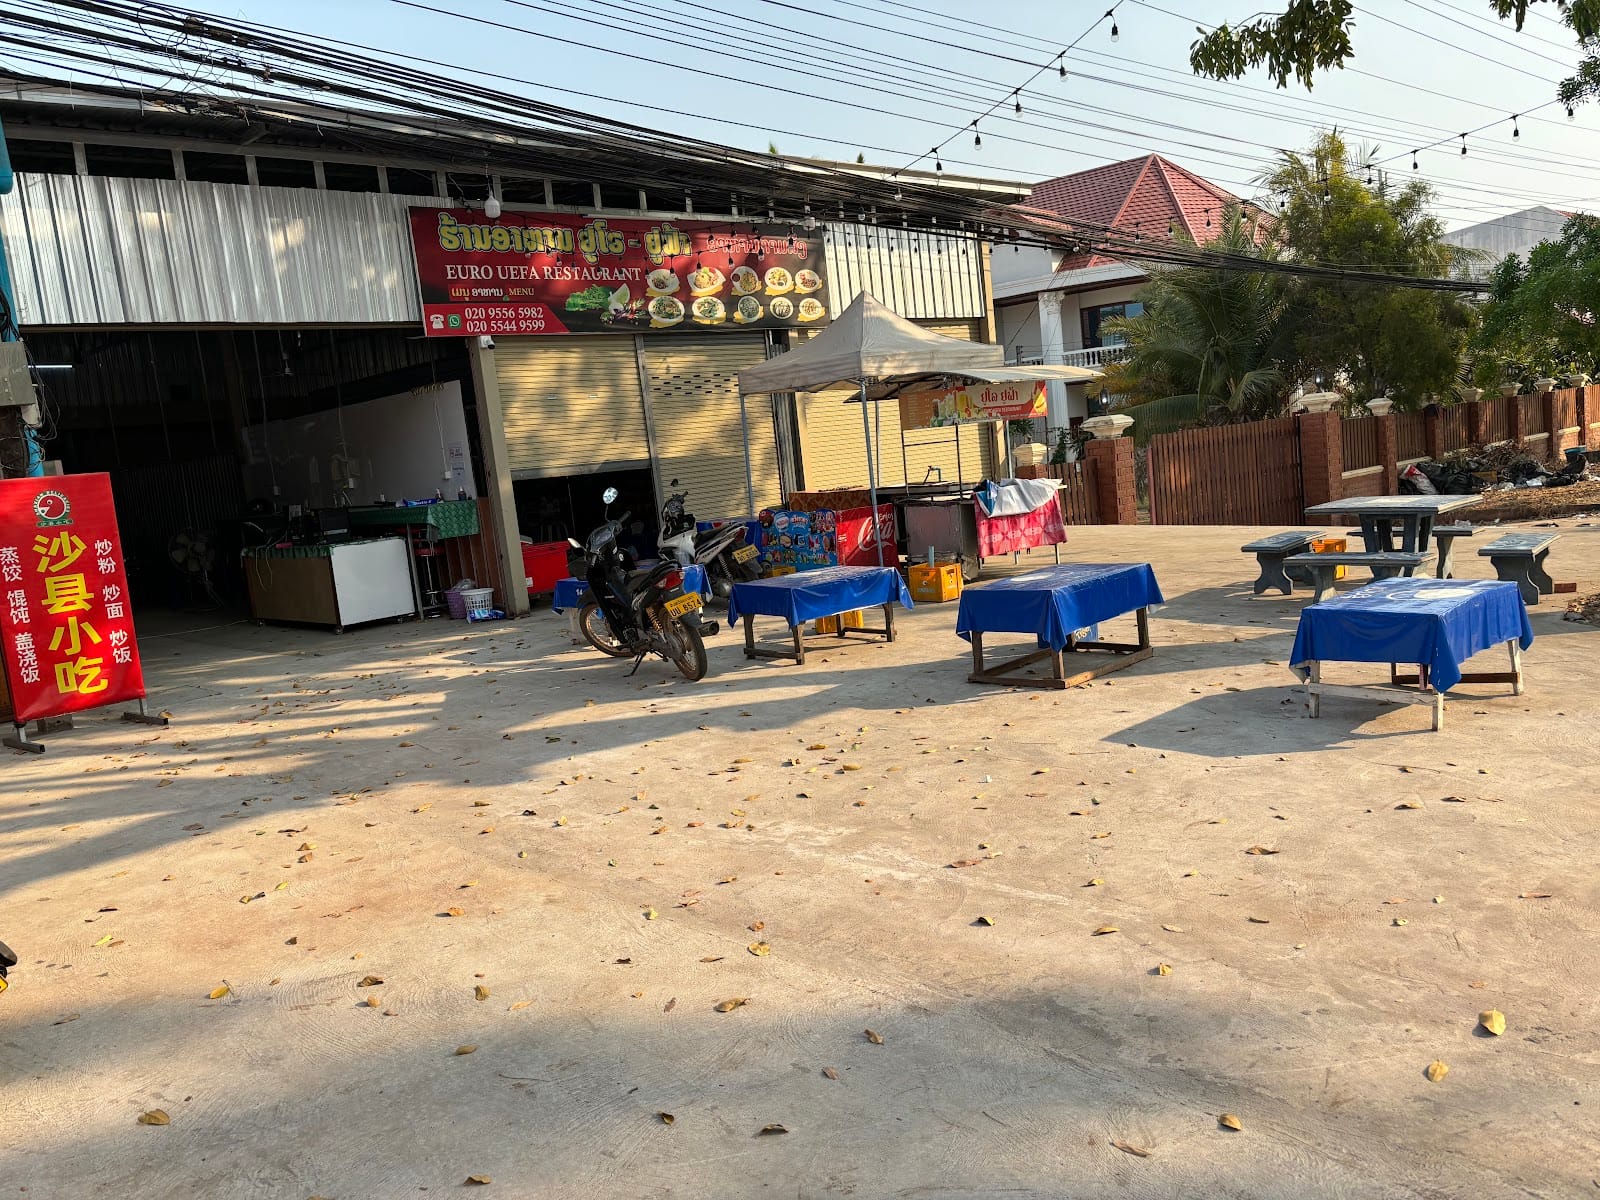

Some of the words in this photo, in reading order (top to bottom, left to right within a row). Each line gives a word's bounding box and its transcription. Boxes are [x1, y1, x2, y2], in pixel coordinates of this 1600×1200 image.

[446, 264, 493, 280] EURO
[496, 265, 539, 280] UEFA
[543, 265, 642, 282] RESTAURANT
[508, 287, 535, 296] MENU
[464, 307, 486, 320] 020
[488, 307, 515, 319] 9556
[518, 307, 544, 319] 5982
[466, 320, 487, 333] 020
[490, 319, 517, 332] 5544
[520, 319, 545, 331] 9599
[0, 546, 23, 582] 蒸饺
[94, 539, 116, 574] 炒粉
[7, 589, 30, 625] 馄饨
[33, 531, 108, 694] 沙县小吃
[102, 584, 124, 619] 炒面
[15, 632, 40, 684] 盖浇饭
[109, 629, 132, 664] 炒饭
